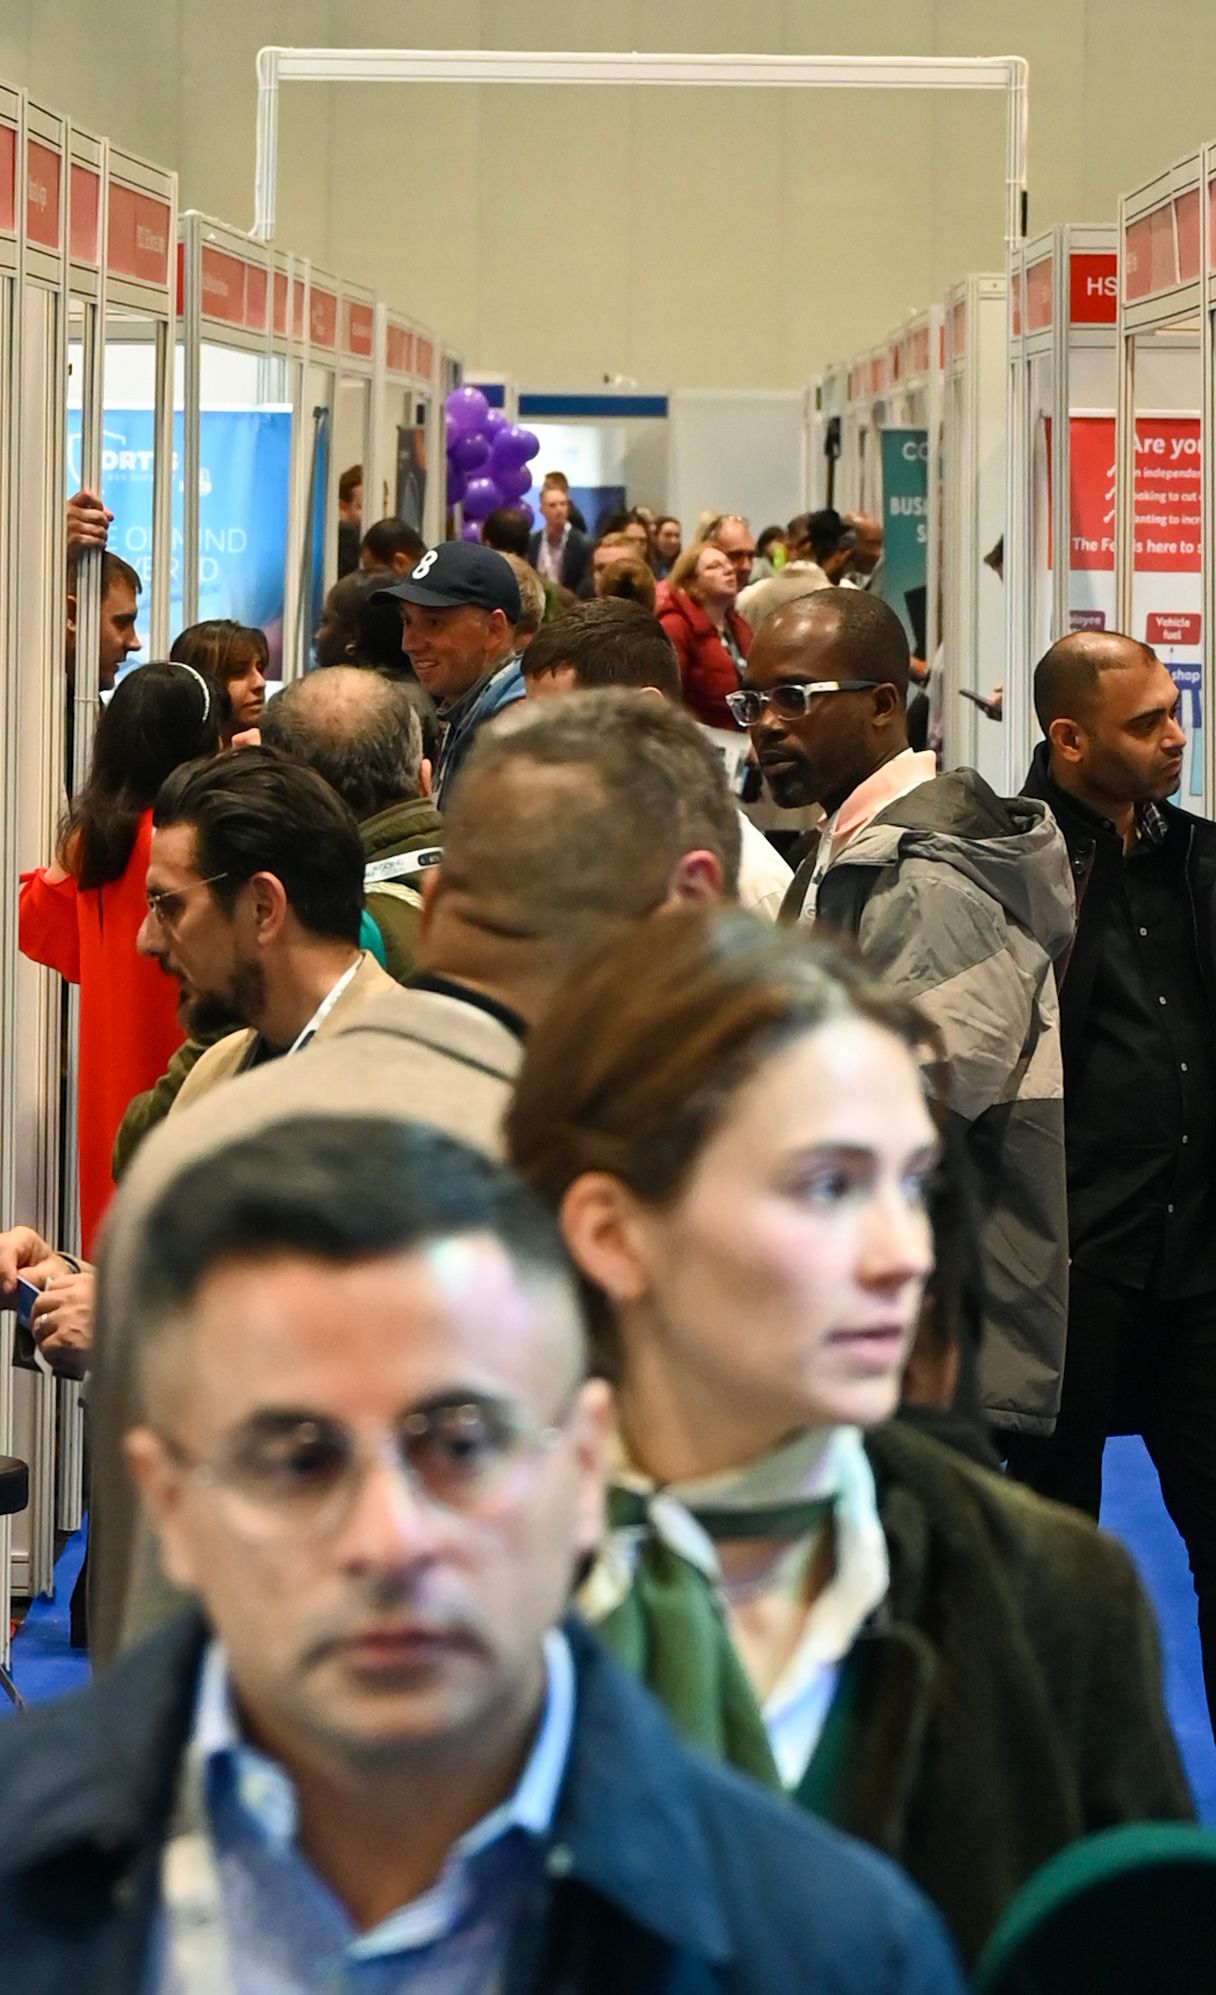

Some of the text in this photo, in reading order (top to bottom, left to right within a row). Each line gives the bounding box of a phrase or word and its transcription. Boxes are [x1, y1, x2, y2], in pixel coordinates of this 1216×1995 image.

[1073, 537, 1098, 552] The
[1147, 539, 1177, 554] here
[1180, 540, 1194, 554] to
[411, 549, 438, 580] 8
[1155, 616, 1191, 629] Vehicle
[1162, 628, 1182, 641] fuel
